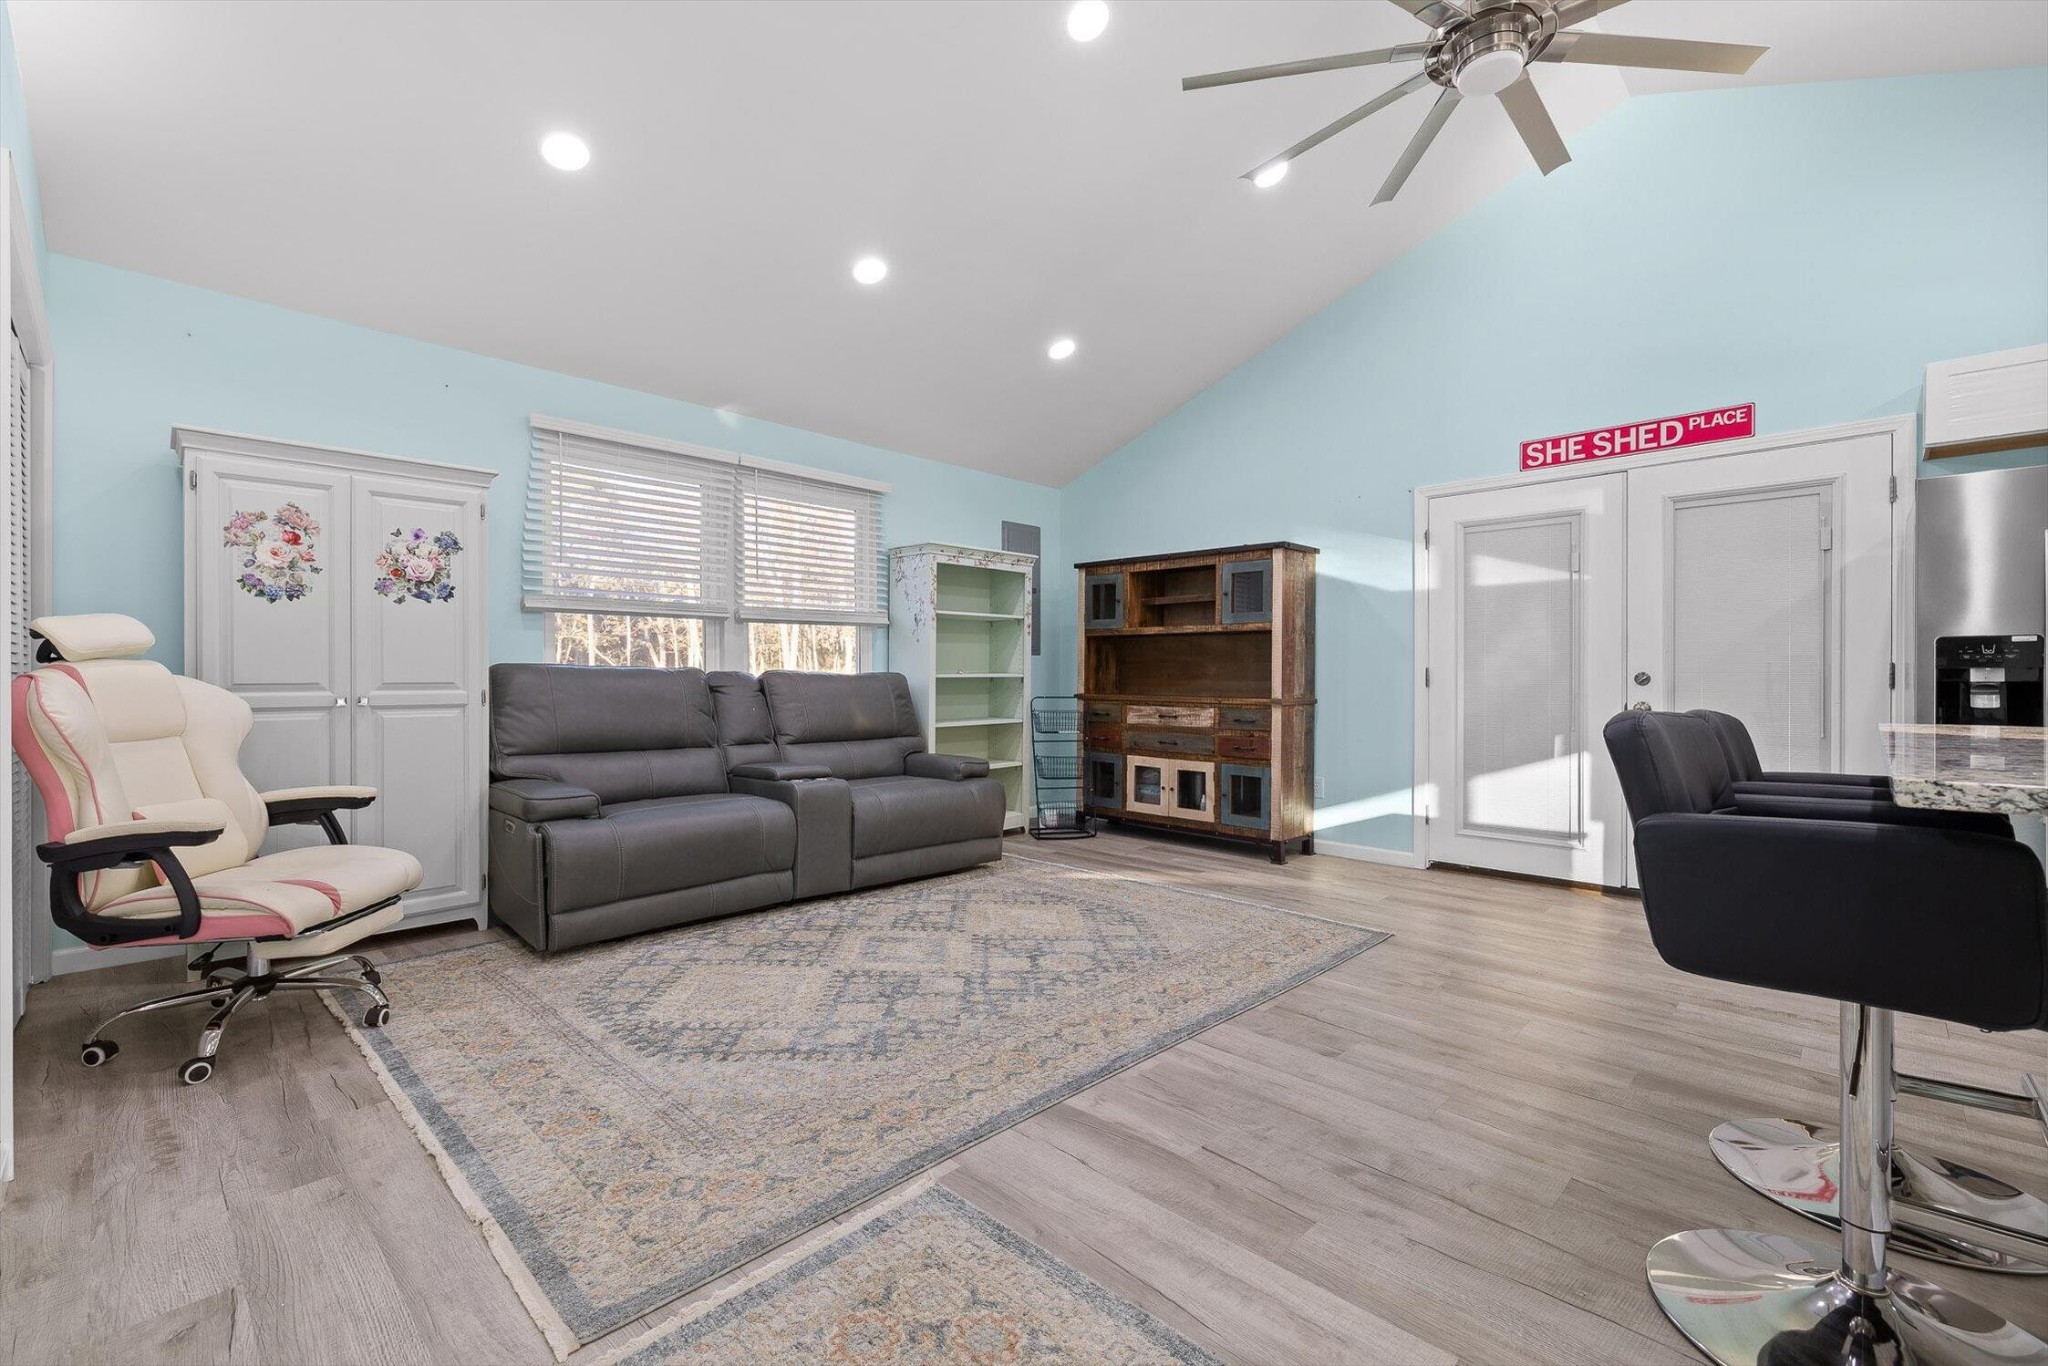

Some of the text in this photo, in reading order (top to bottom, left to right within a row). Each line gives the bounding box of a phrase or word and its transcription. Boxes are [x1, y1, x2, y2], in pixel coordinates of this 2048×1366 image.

[1526, 408, 1748, 466] SHE SHED PLACE
